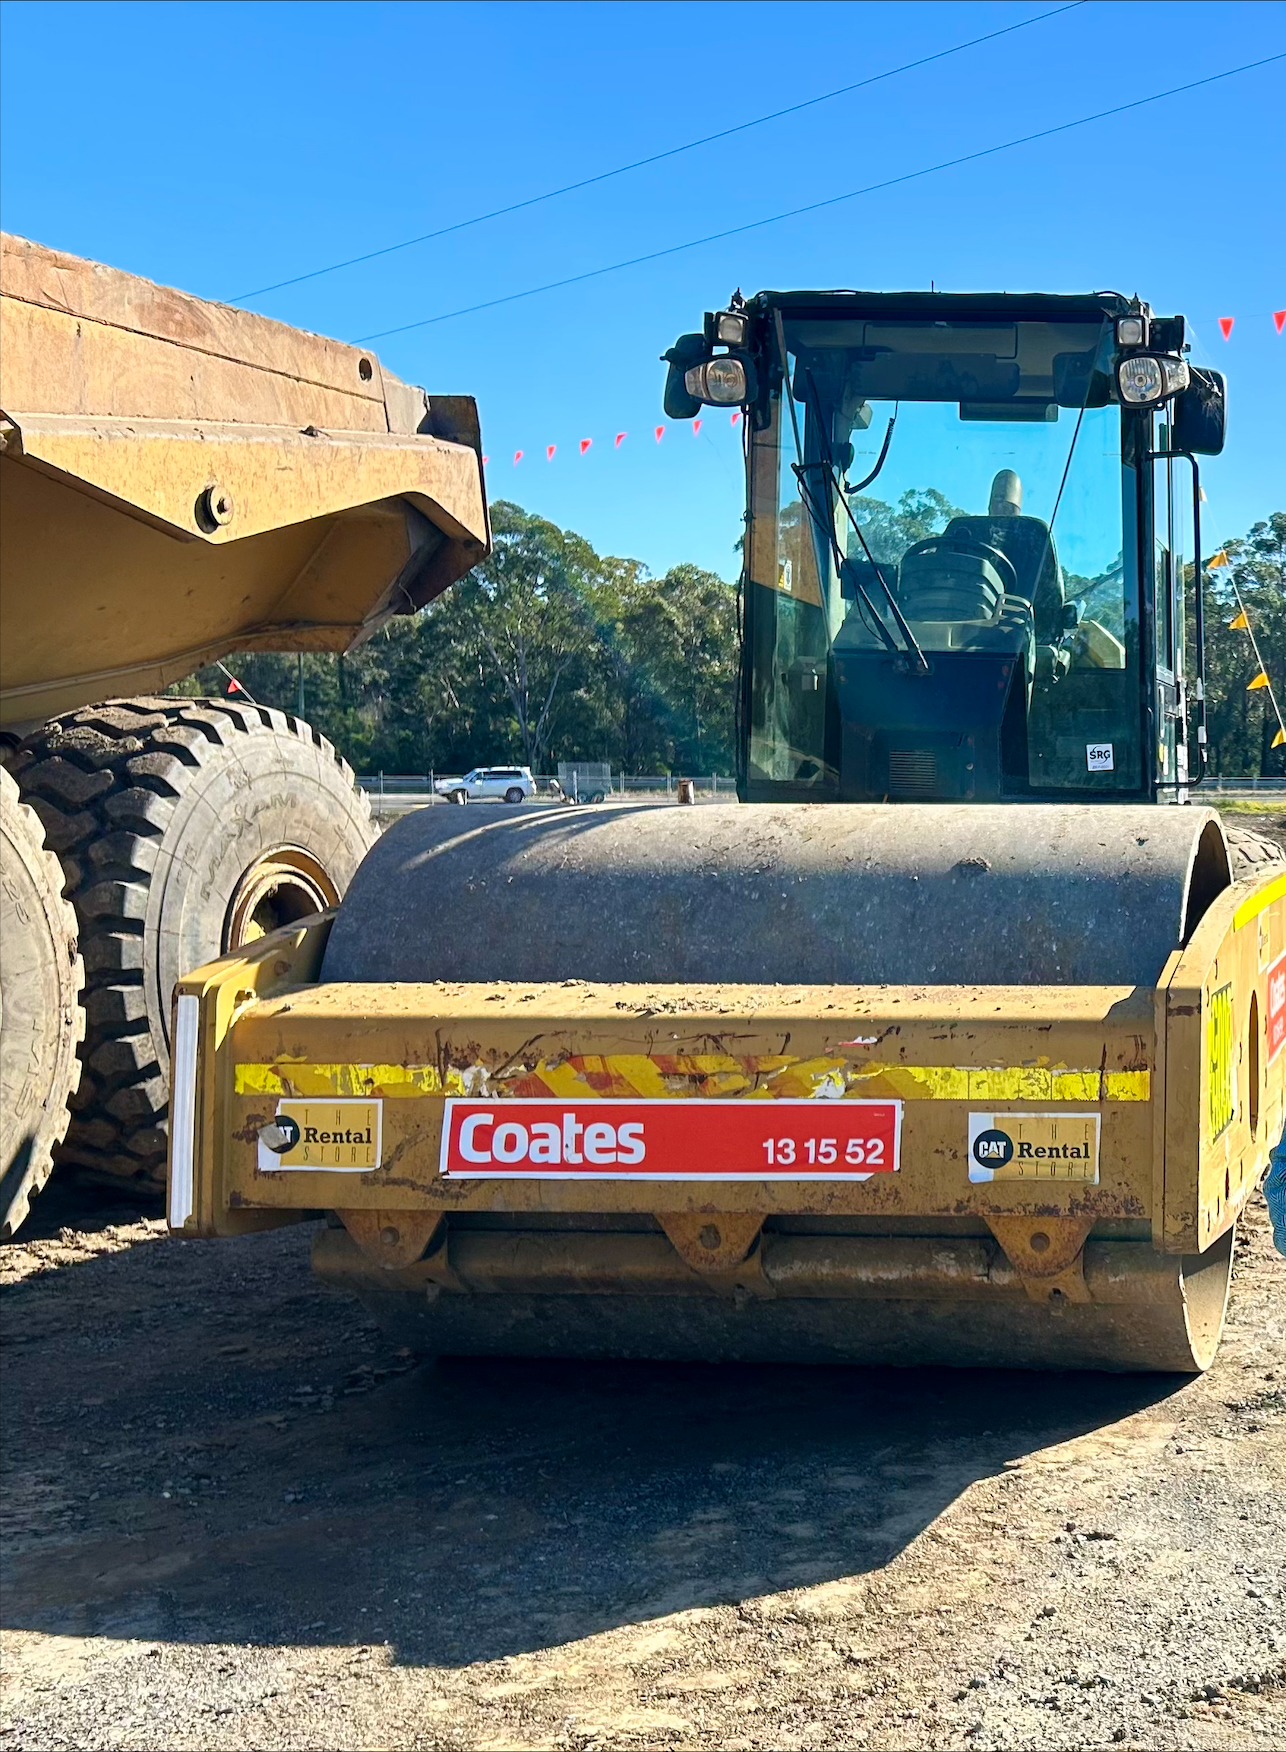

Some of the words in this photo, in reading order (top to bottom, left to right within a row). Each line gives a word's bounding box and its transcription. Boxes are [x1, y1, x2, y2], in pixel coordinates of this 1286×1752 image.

[1089, 750, 1111, 760] SRG
[305, 1109, 371, 1126] THE
[303, 1127, 372, 1144] Rental
[459, 1112, 646, 1165] Coates
[1019, 1123, 1089, 1140] THE
[303, 1146, 371, 1163] STORE
[762, 1138, 796, 1165] 13
[804, 1138, 838, 1165] 15
[844, 1138, 885, 1165] 52
[978, 1141, 1007, 1158] CAT
[1017, 1142, 1090, 1159] Rental
[1018, 1161, 1089, 1178] STORE
